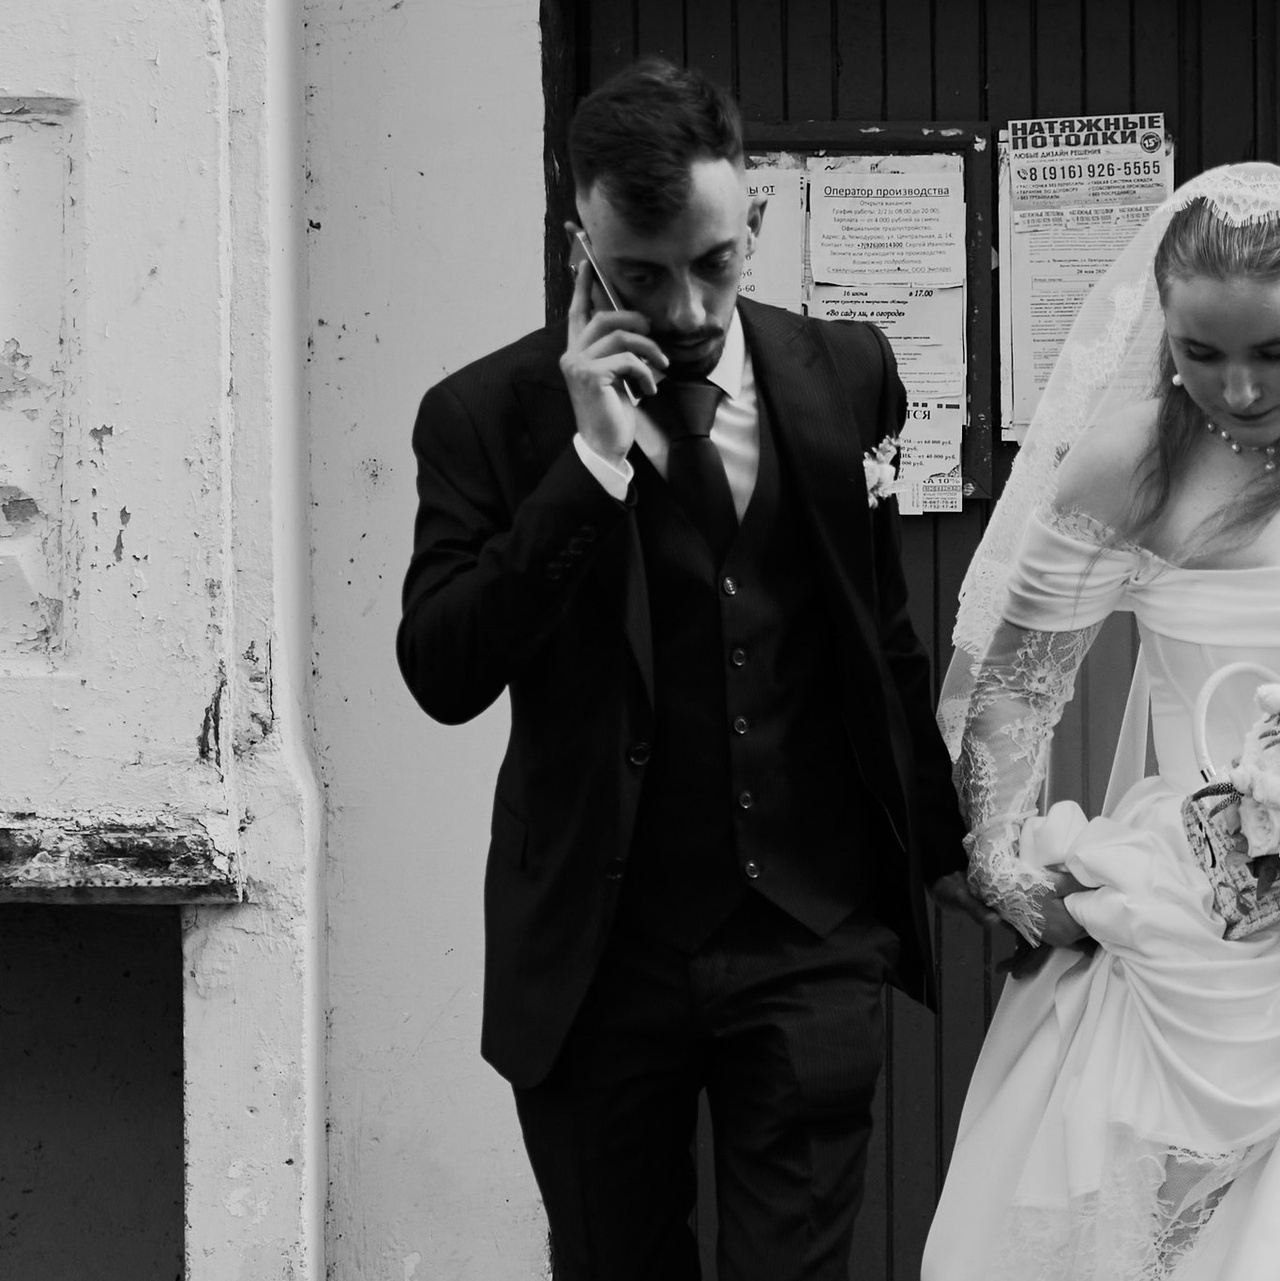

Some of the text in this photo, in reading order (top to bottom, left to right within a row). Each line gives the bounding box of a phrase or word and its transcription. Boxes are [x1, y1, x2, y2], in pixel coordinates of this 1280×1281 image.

[1011, 115, 1161, 136] НАТЯЖНЫЕ
[1012, 131, 1137, 150] ПОТОЛКИ
[1030, 161, 1160, 181] 8 (916) 926-5555
[824, 186, 950, 198] Оператор производства
